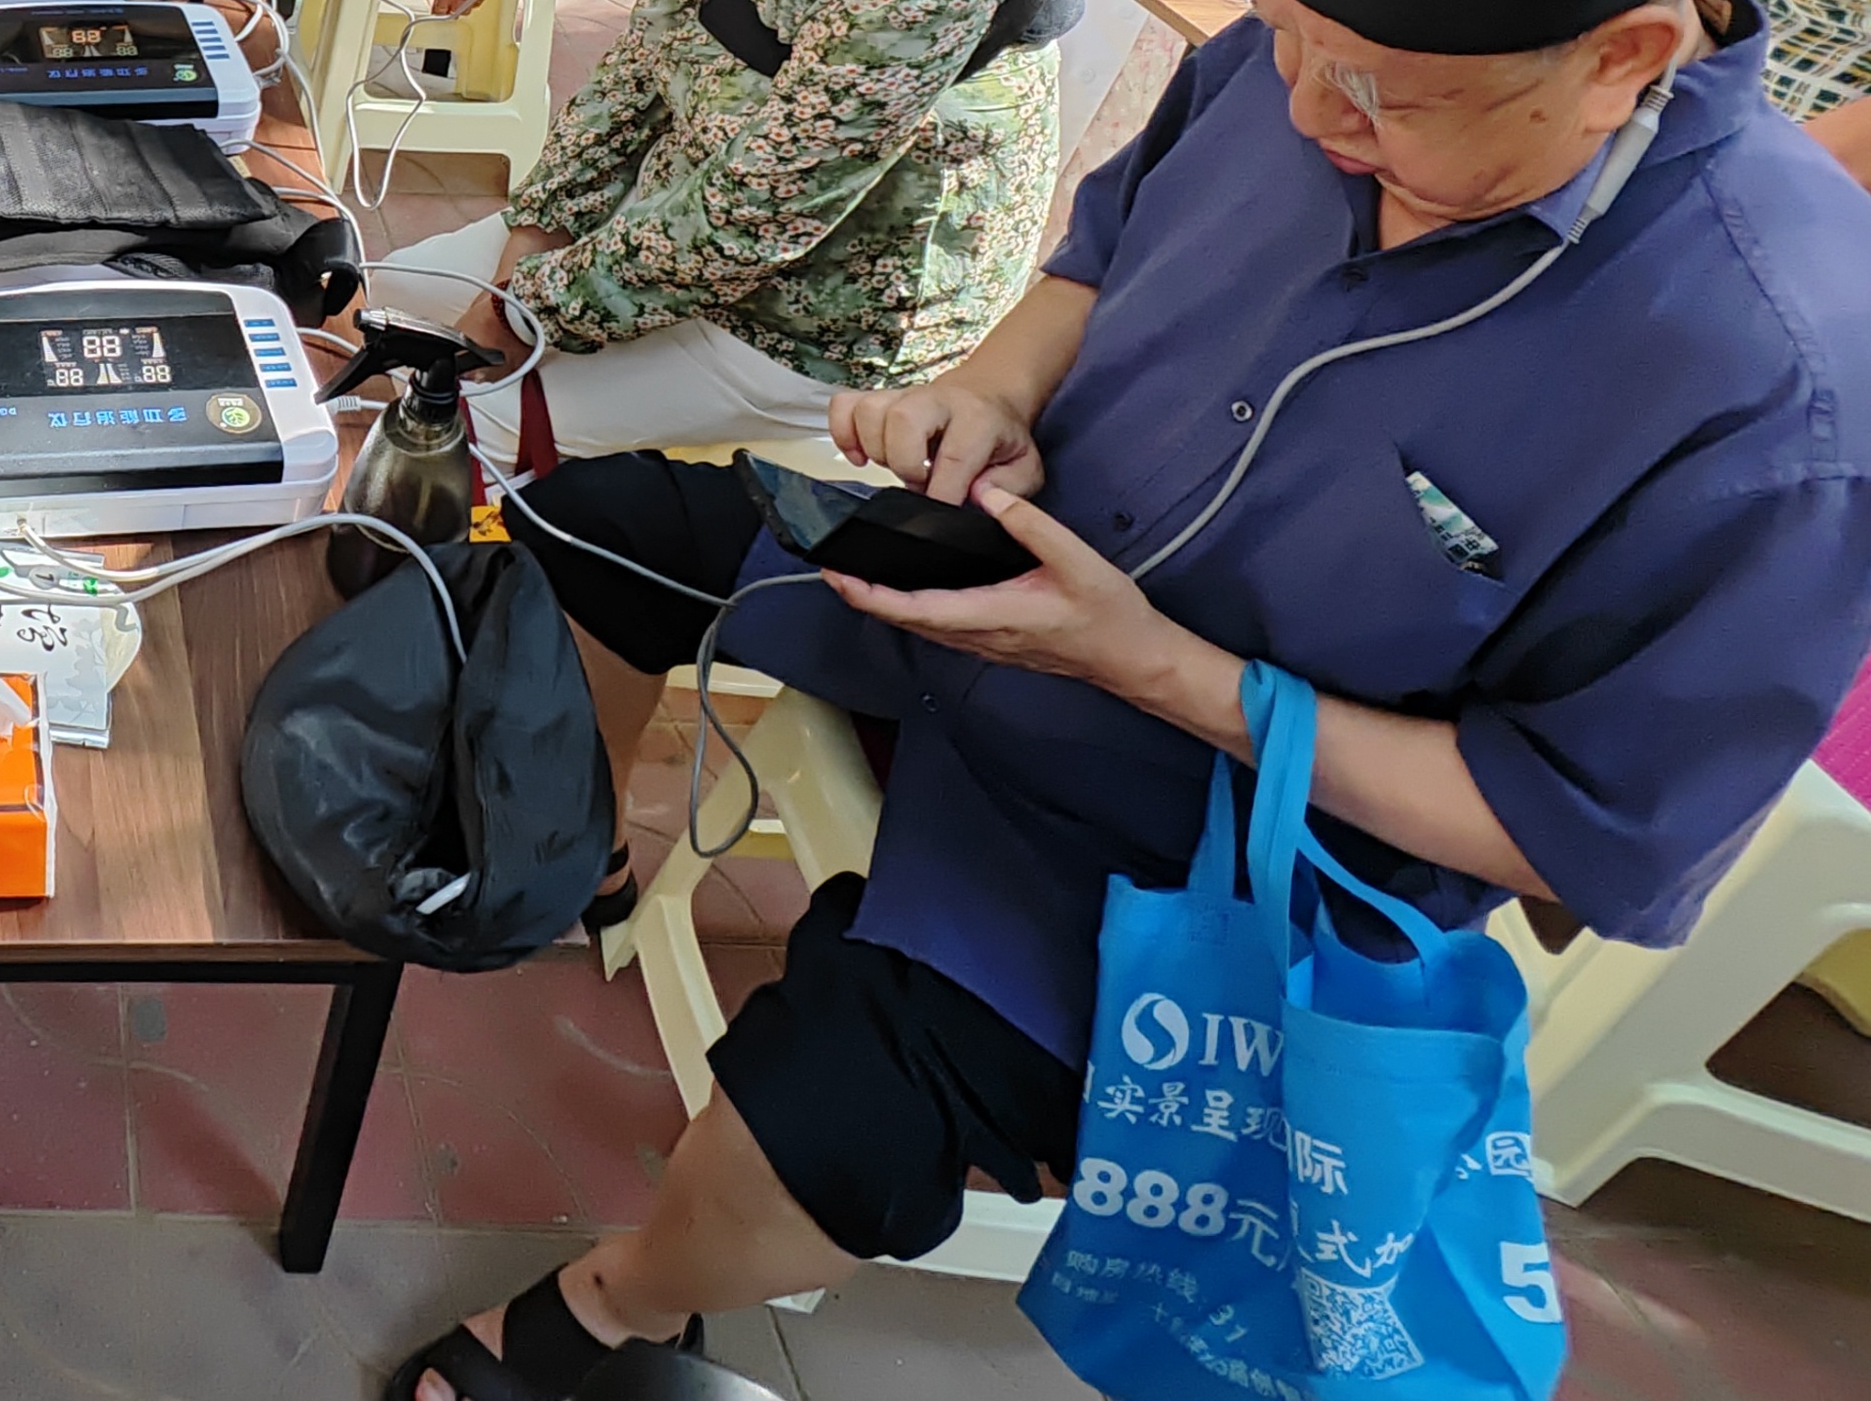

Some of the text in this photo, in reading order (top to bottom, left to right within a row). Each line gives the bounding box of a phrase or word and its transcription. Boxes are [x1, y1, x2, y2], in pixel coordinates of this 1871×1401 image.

[47, 406, 188, 428] 多功能治疗仪
[1097, 1074, 1288, 1151] 实景呈现
